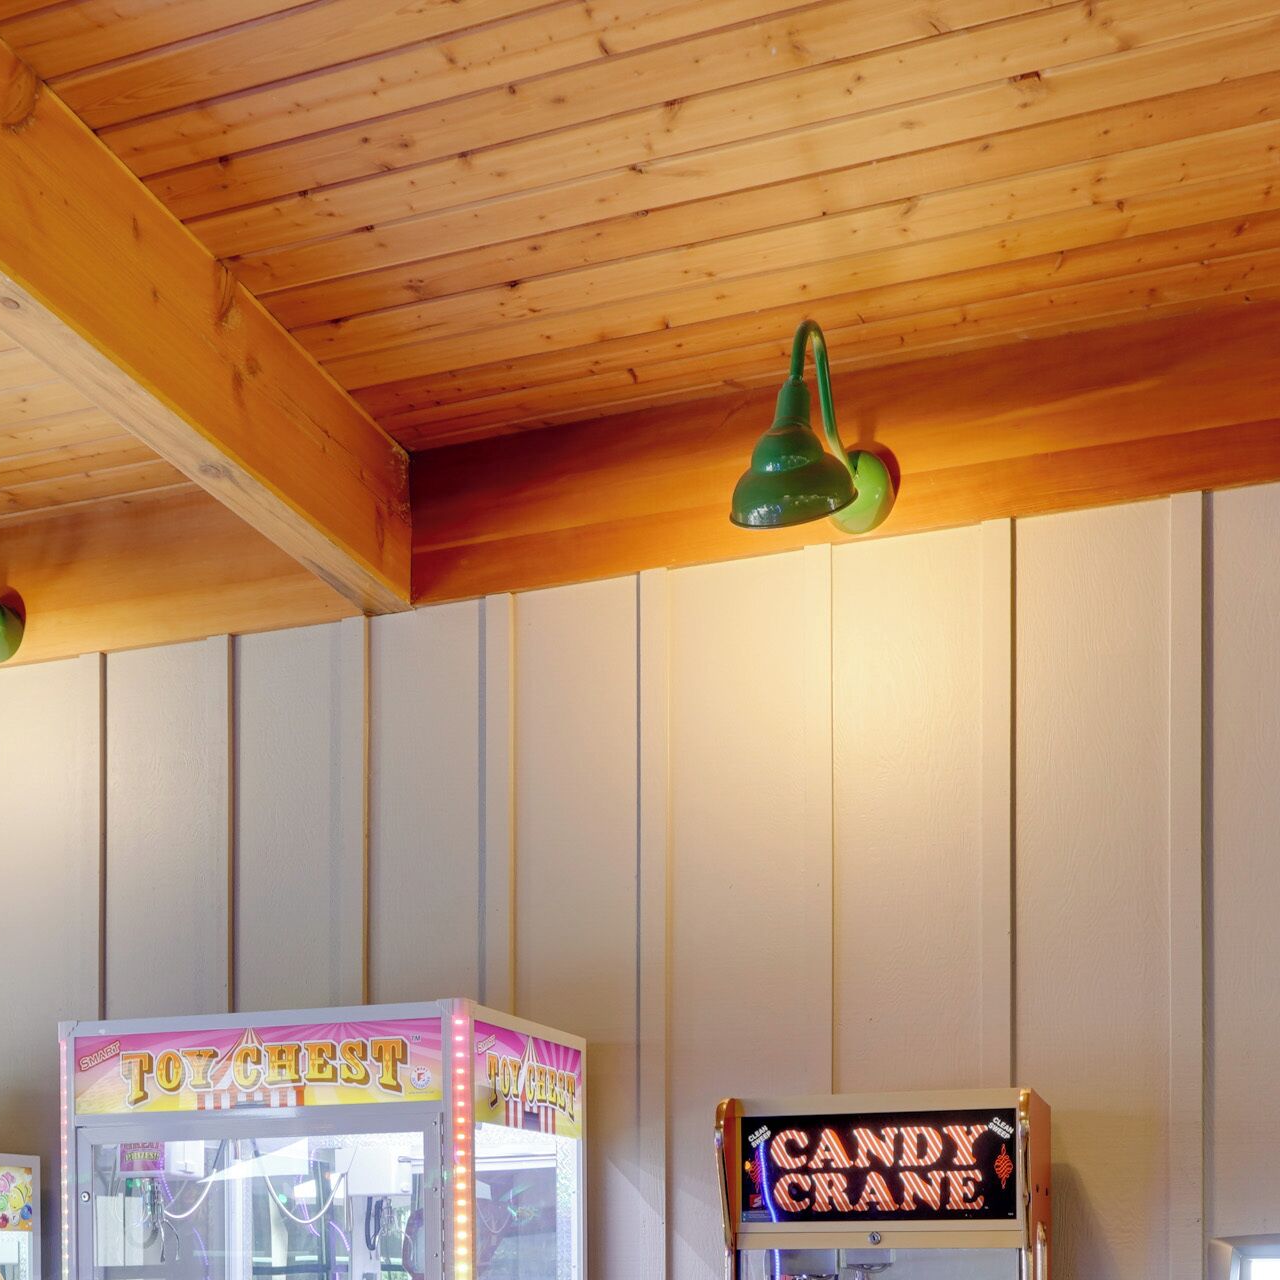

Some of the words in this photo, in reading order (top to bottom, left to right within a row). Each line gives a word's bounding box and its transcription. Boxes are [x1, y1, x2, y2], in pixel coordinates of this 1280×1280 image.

[80, 1040, 120, 1071] SMART
[121, 1048, 218, 1107] TOY
[234, 1037, 409, 1094] CHEST
[486, 1051, 521, 1110] TOY
[526, 1063, 578, 1124] CHEST
[748, 1124, 768, 1141] CLEAN
[751, 1130, 772, 1148] SWEEP
[988, 1122, 1011, 1140] SWEEP
[992, 1117, 1014, 1134] CLEAN
[770, 1124, 988, 1170] CANDY
[773, 1169, 985, 1212] CRANE
